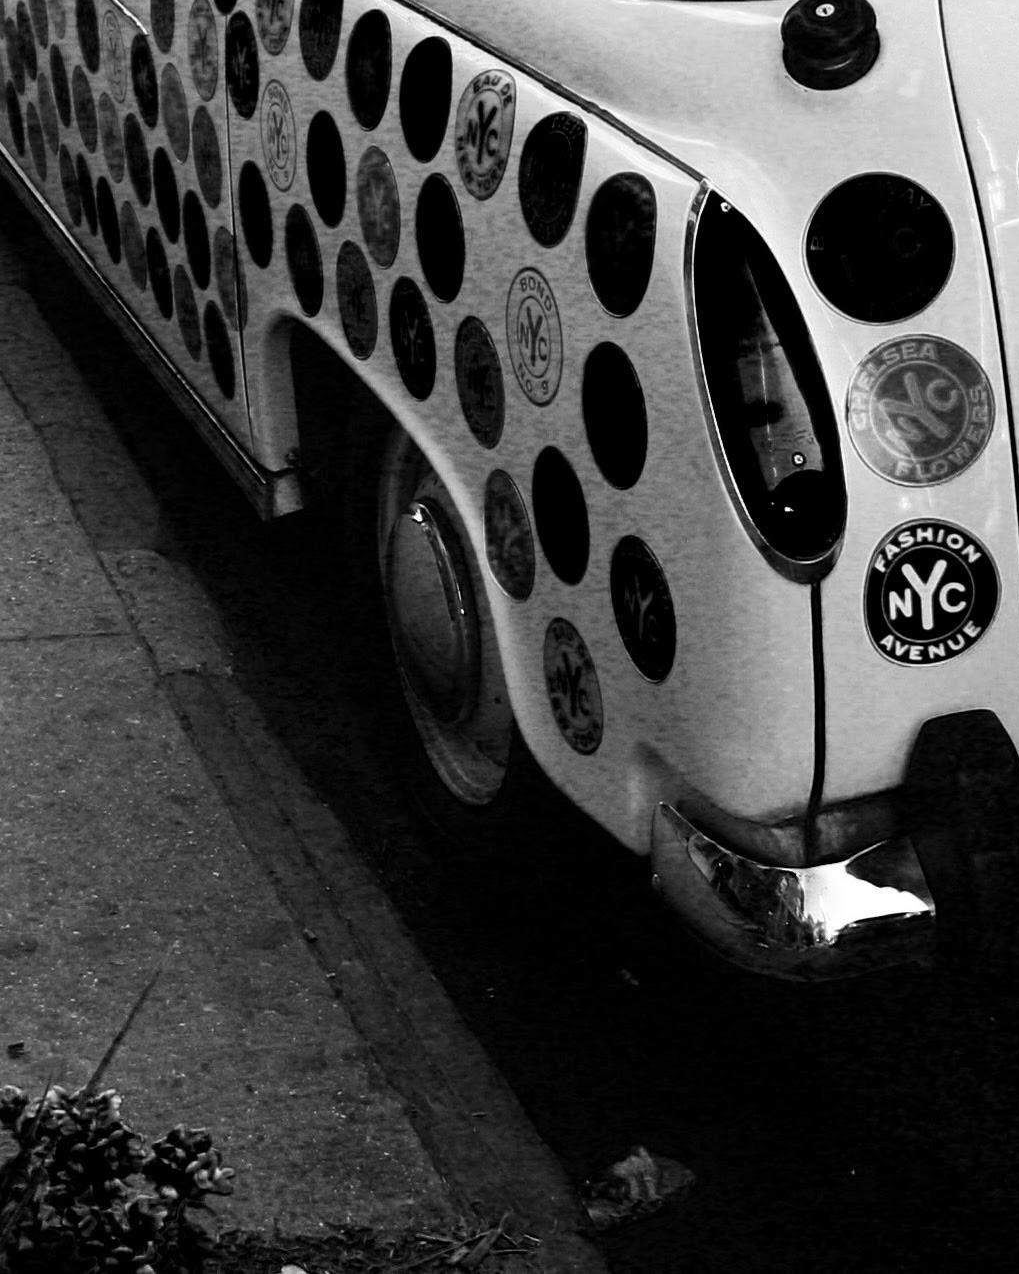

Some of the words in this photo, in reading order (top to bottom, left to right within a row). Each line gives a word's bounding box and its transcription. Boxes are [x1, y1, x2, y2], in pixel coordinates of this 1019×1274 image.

[473, 74, 501, 94] EAU
[466, 99, 499, 165] NYC
[520, 276, 553, 312] BOND
[520, 306, 548, 367] NYC
[852, 341, 939, 431] CHELSEA
[877, 370, 960, 444] NYC
[893, 385, 990, 481] FLOWERS
[874, 526, 981, 573] FASHION
[888, 558, 967, 631] NYC
[880, 619, 982, 662] AVENUE
